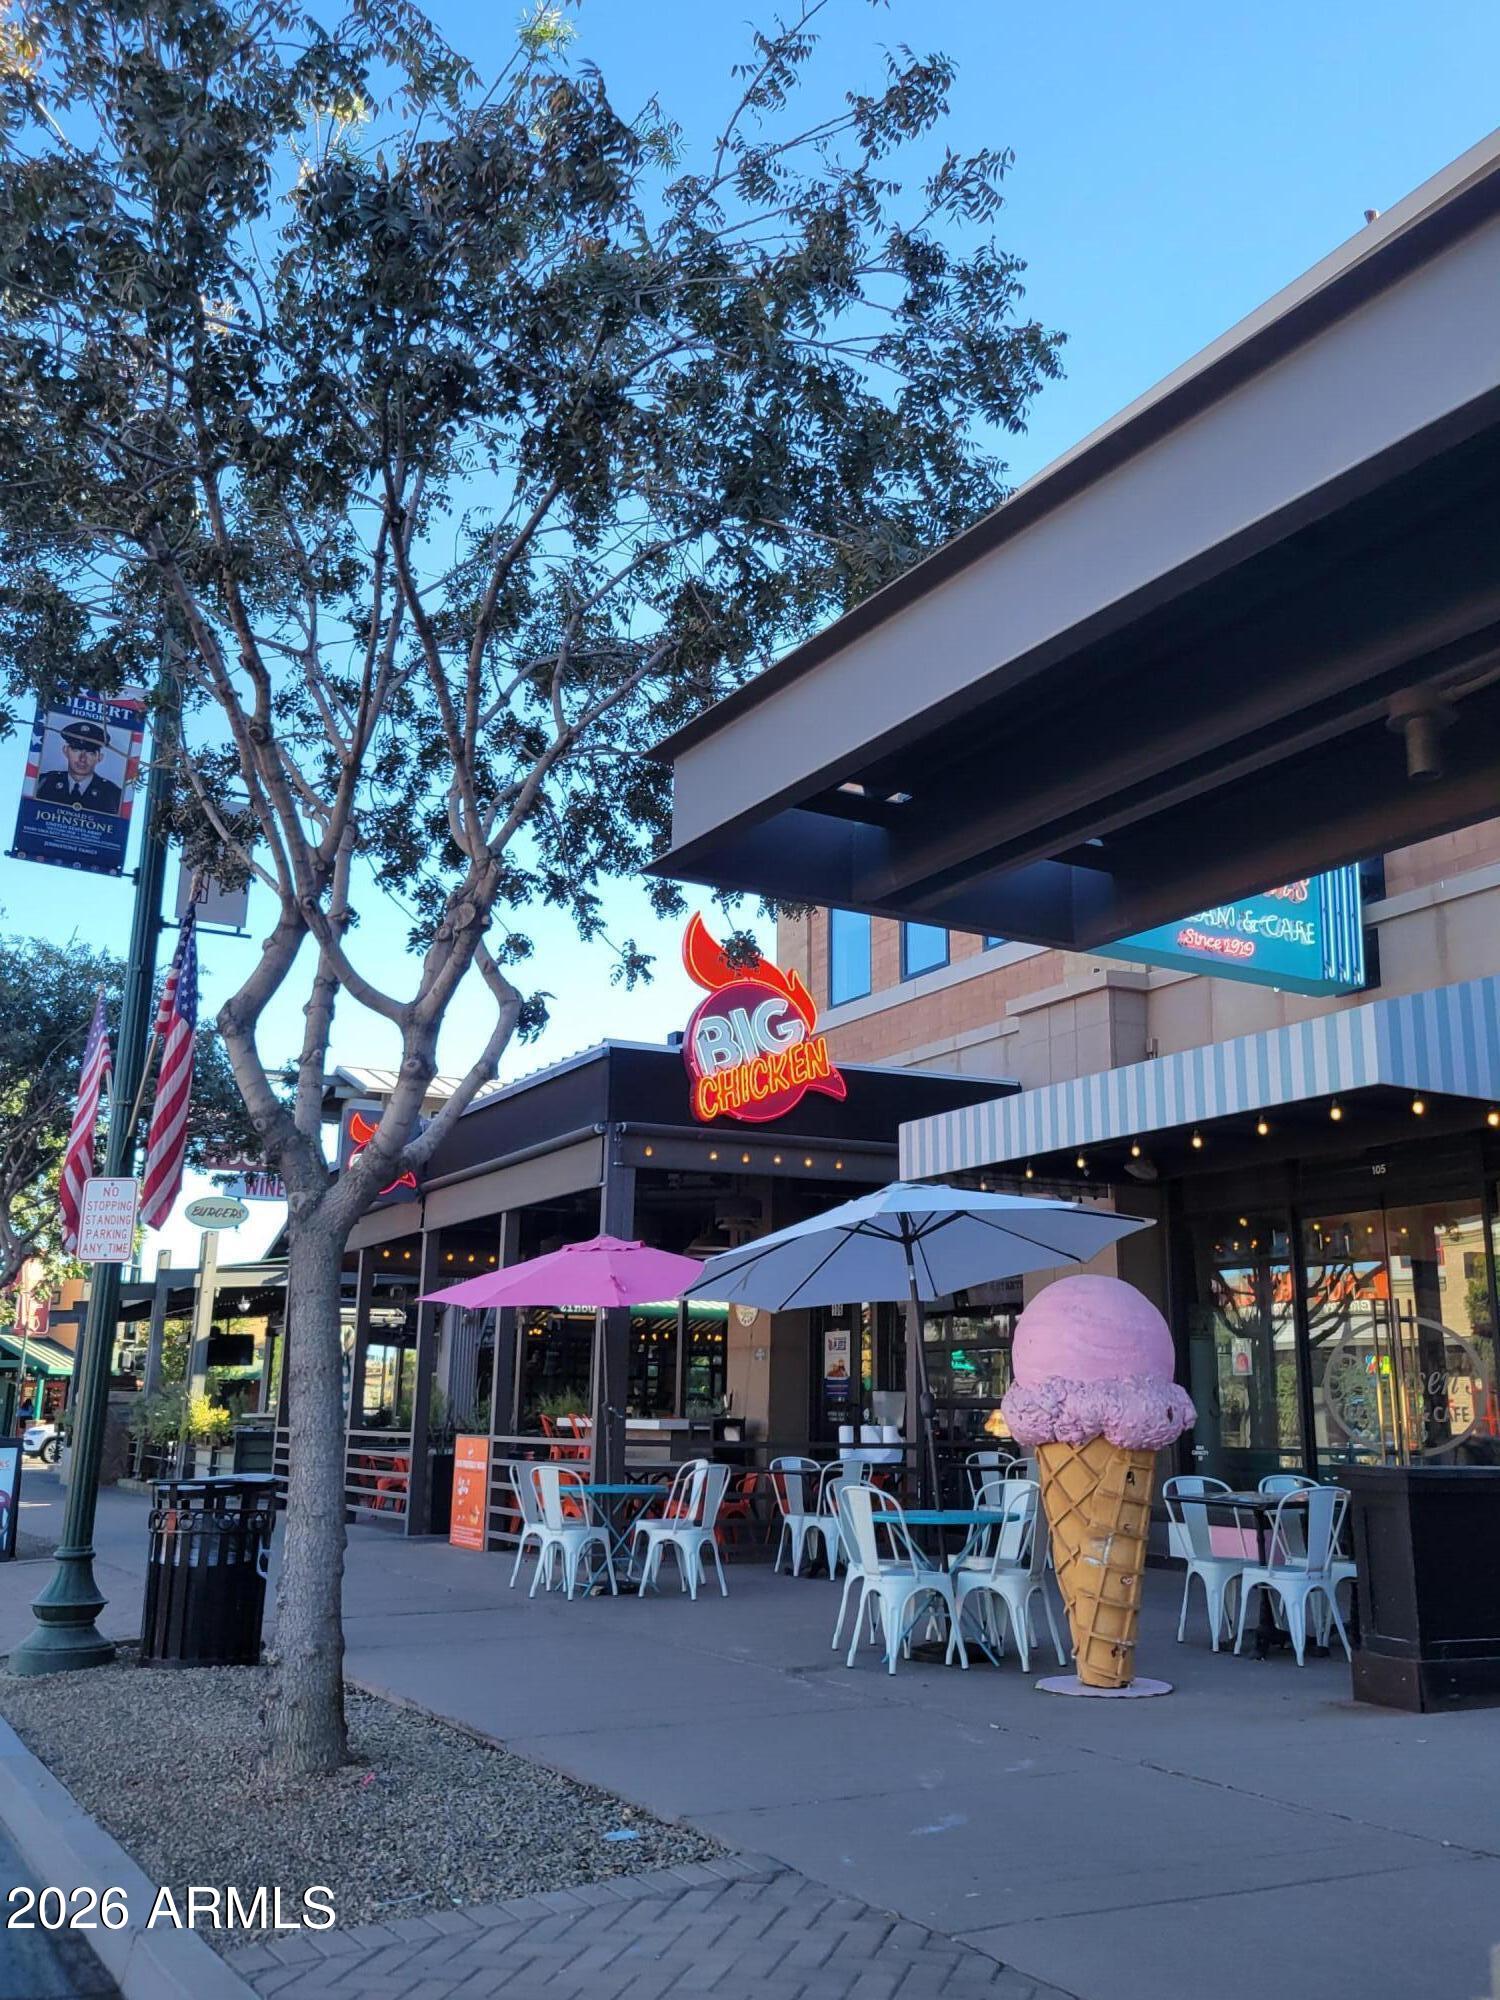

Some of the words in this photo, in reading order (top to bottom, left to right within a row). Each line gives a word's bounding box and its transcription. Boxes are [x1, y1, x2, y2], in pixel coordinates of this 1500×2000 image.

[54, 696, 133, 720] ILBERT
[36, 810, 113, 833] JOHNSTONE
[1243, 910, 1259, 933] &
[1182, 928, 1222, 950] Since
[1223, 938, 1255, 957] 1919
[695, 998, 805, 1076] BIG
[698, 1037, 831, 1119] CHICKEN
[1372, 1164, 1386, 1175] 105
[103, 1187, 120, 1197] NO
[245, 1177, 286, 1198] WINE
[87, 1201, 132, 1211] STOPPING
[191, 1206, 245, 1218] BURGERS
[85, 1215, 131, 1225] STANDING
[86, 1229, 127, 1239] PARKING
[82, 1243, 103, 1253] ANY
[108, 1243, 128, 1253] TIME
[1433, 1406, 1470, 1423] CAFE
